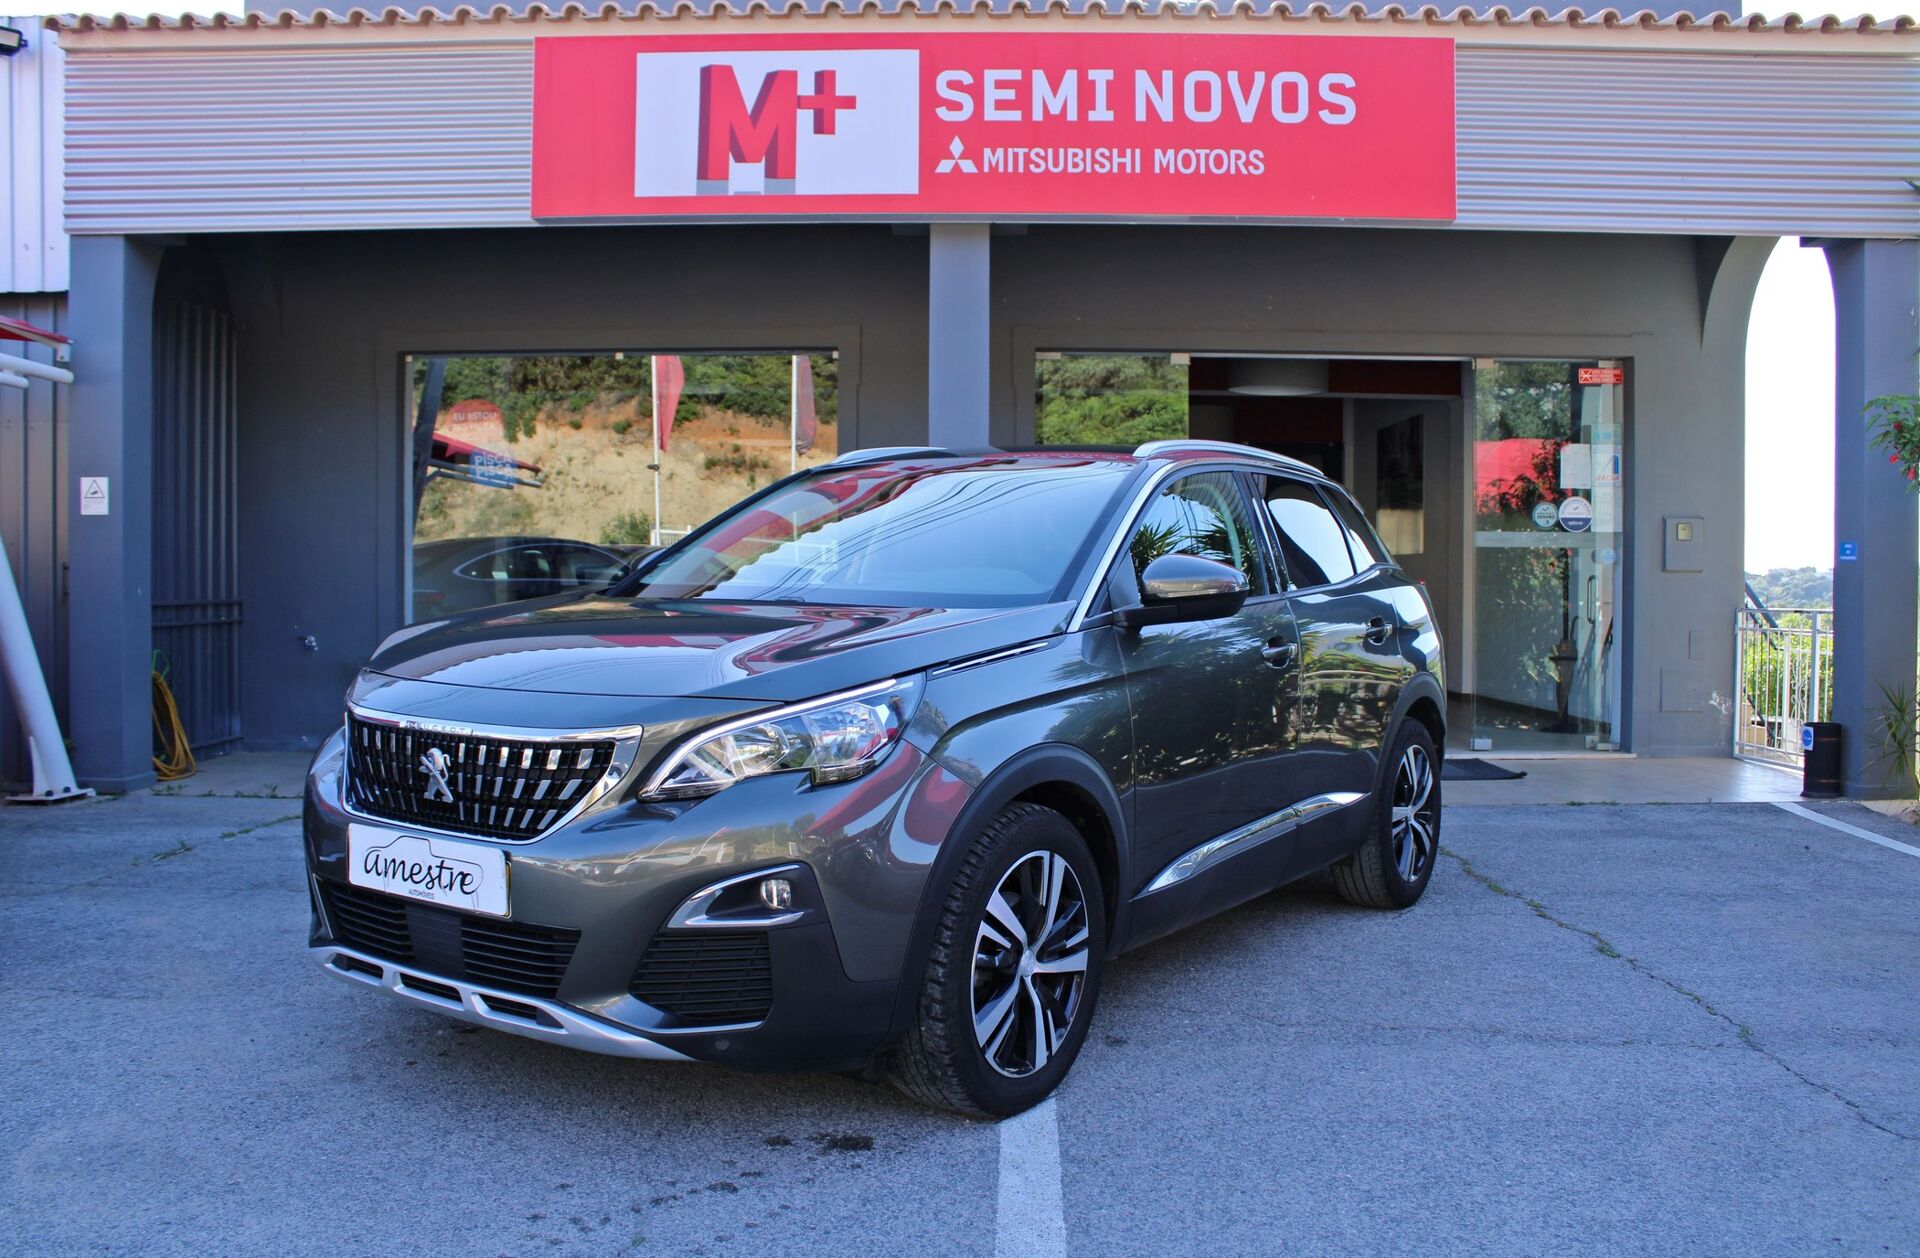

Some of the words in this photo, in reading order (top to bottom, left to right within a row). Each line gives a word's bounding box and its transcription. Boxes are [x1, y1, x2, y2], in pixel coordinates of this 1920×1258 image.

[935, 68, 1114, 122] SEMI
[1135, 69, 1357, 125] NOVOS
[983, 146, 1141, 174] MITSUBISHI
[1154, 148, 1265, 176] MOTORS
[364, 849, 474, 895] amestre
